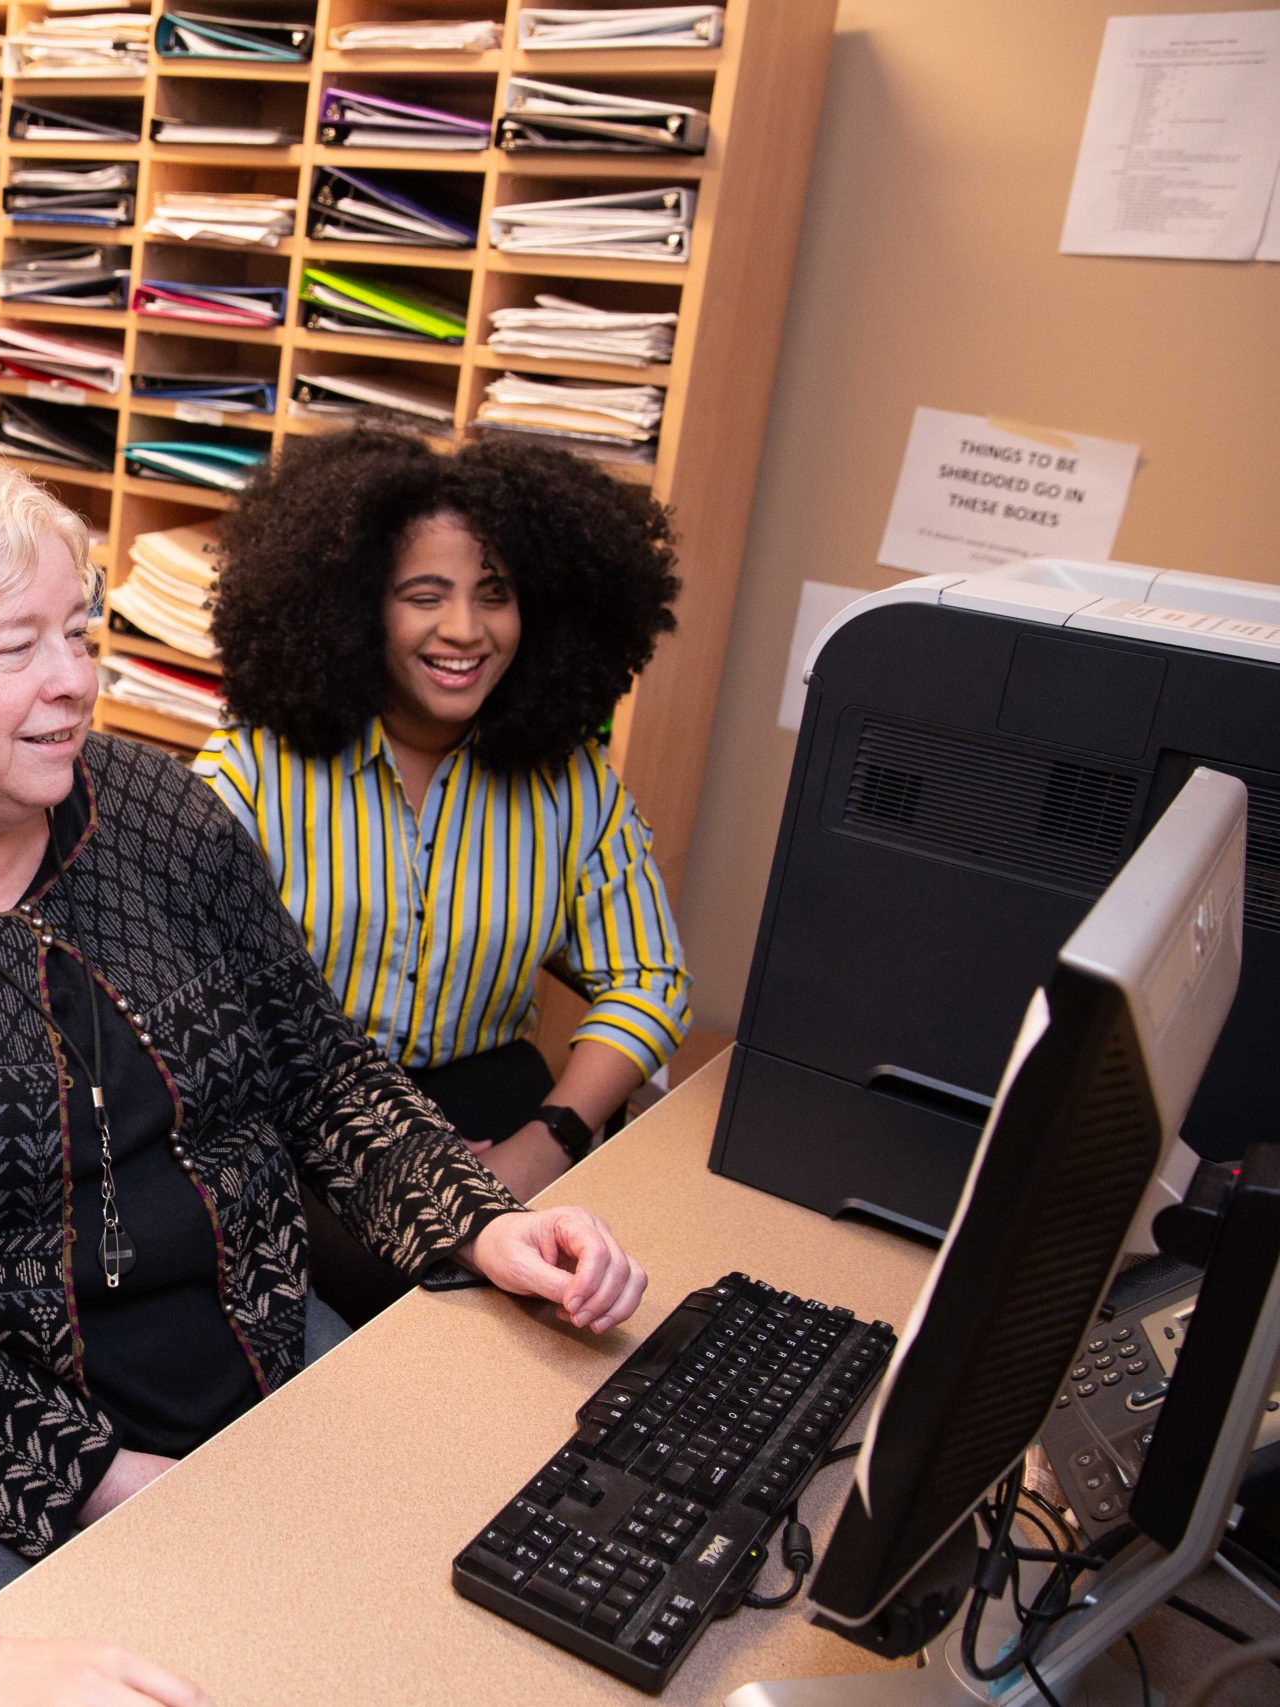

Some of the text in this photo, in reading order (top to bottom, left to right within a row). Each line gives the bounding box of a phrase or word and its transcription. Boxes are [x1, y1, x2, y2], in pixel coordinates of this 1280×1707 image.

[960, 439, 1079, 474] THINGS TO BE
[938, 463, 1086, 503] SHREDDED GO IN
[949, 492, 1060, 528] THESE BOXES
[698, 1535, 731, 1564] DELL
